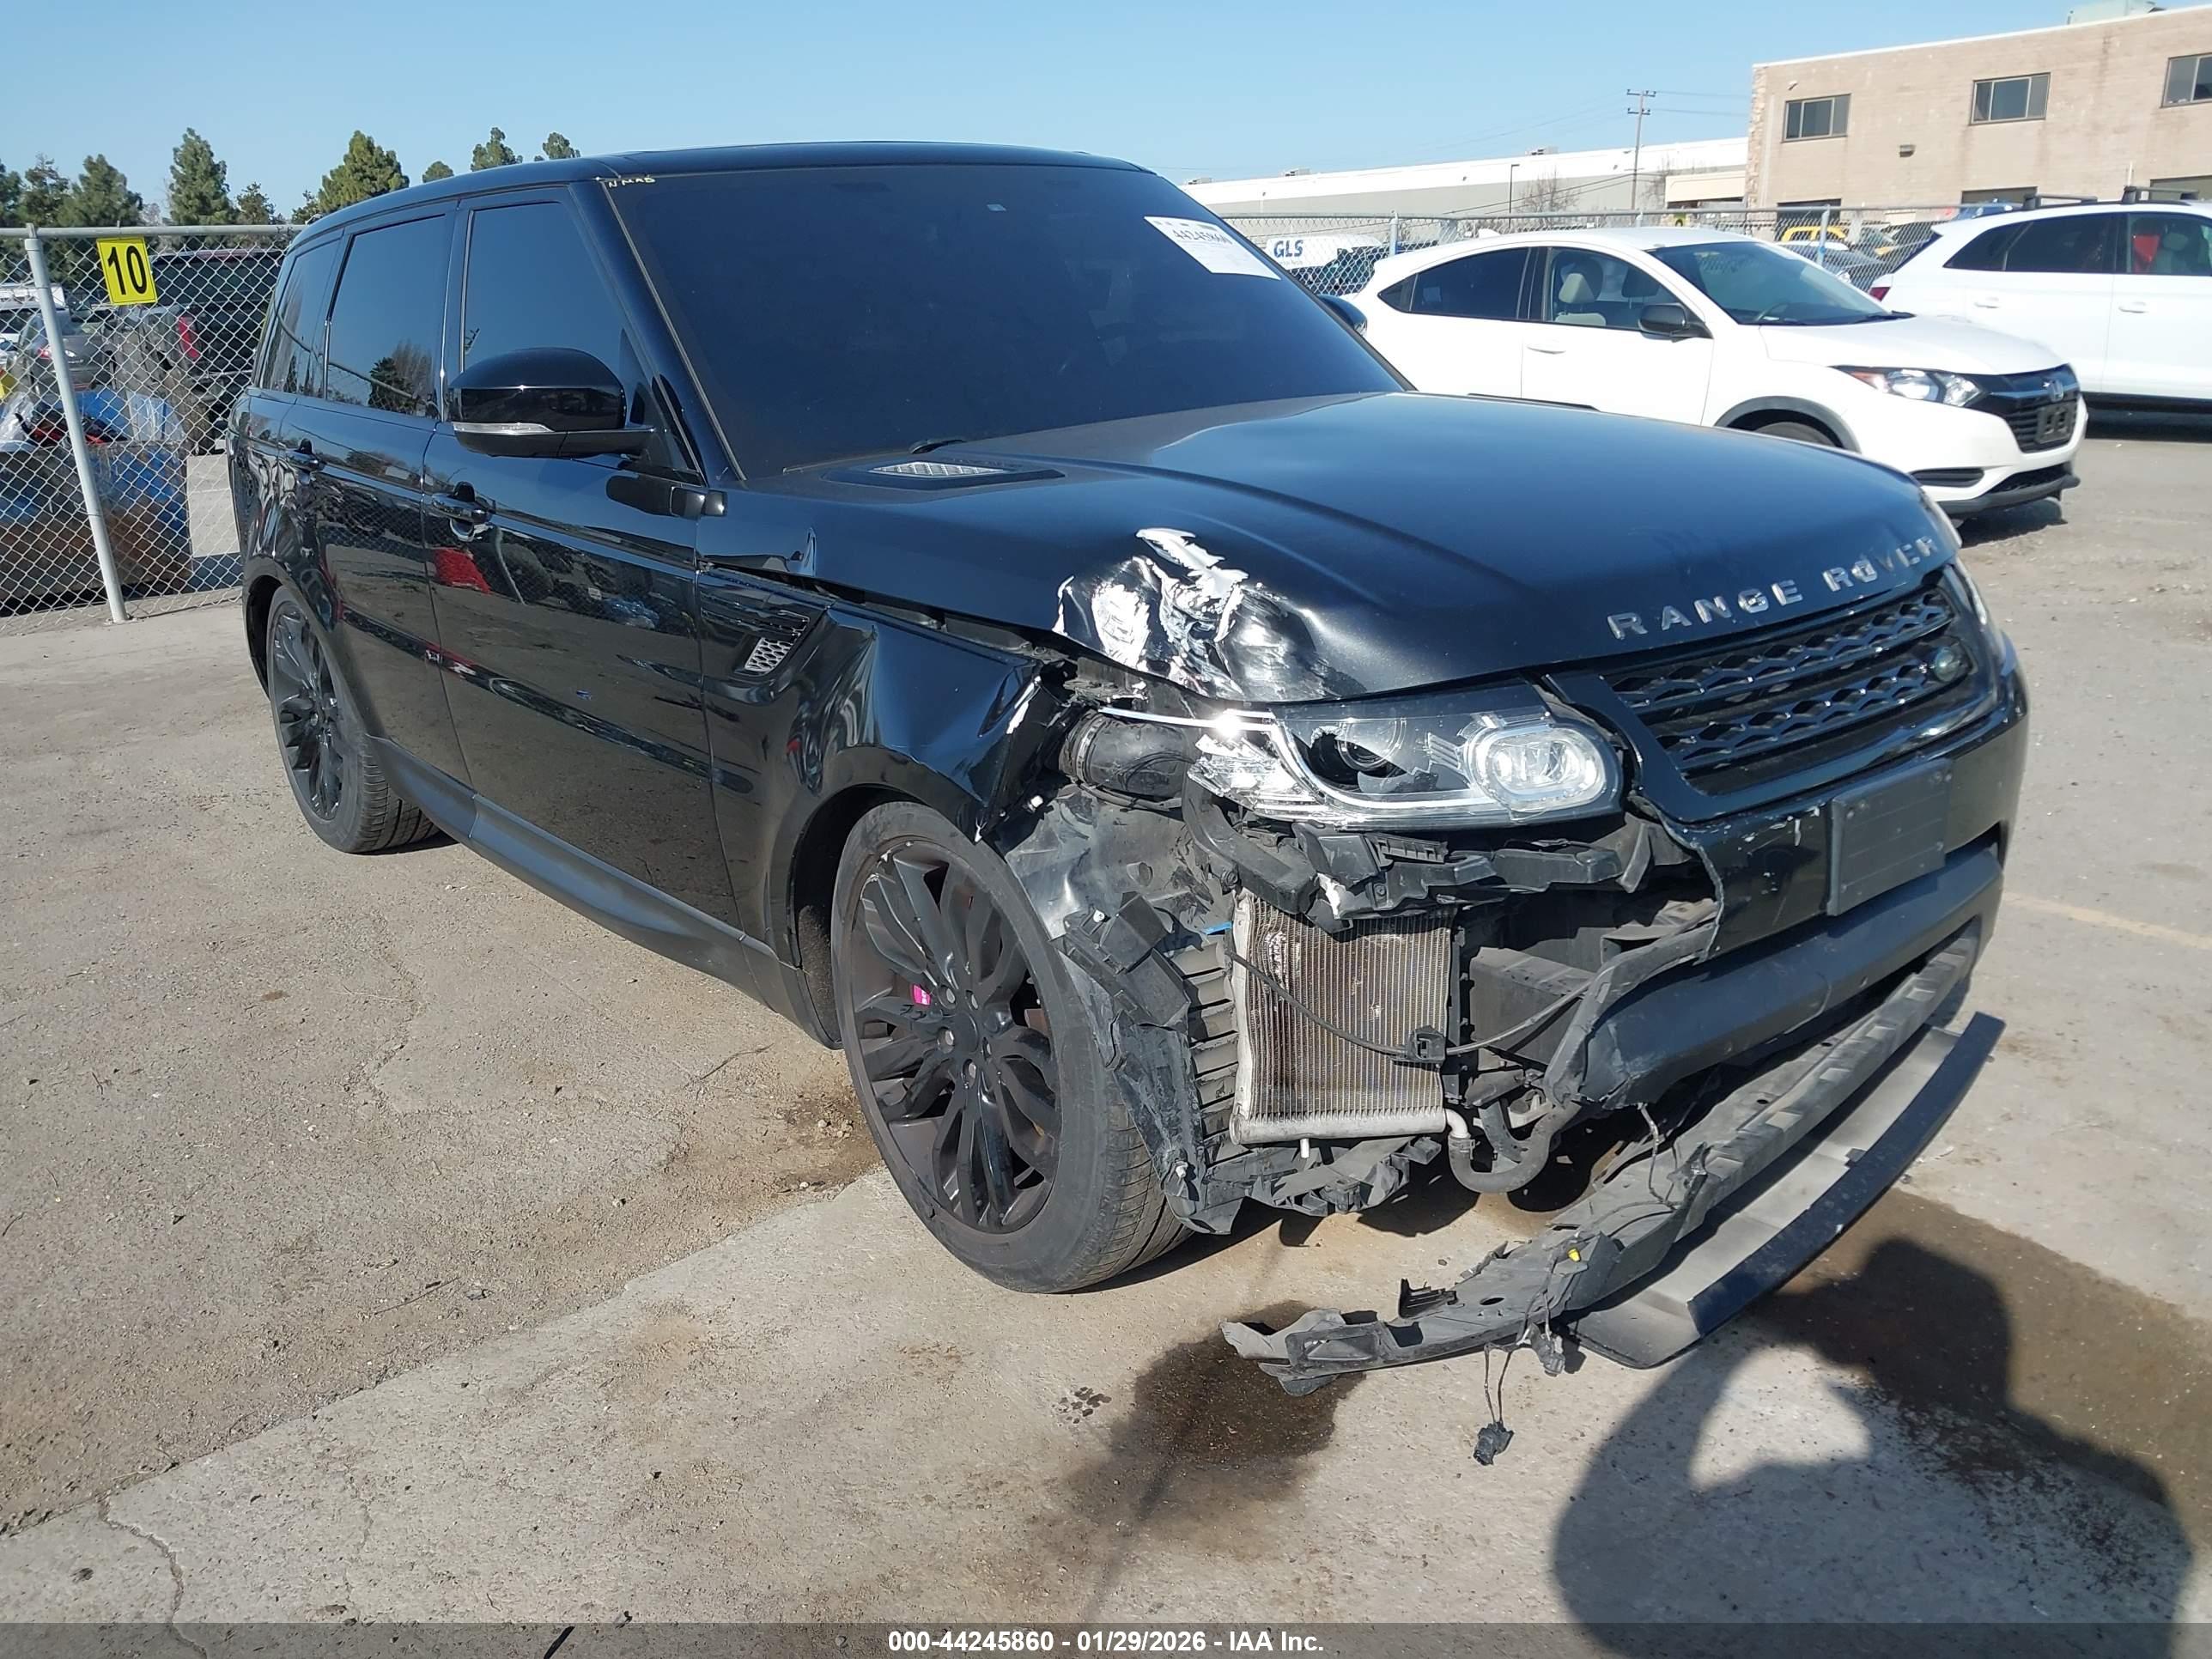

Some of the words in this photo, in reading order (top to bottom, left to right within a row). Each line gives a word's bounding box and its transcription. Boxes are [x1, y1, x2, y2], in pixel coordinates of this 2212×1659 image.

[107, 246, 148, 295] 10
[1273, 240, 1304, 258] GLS
[1607, 579, 1803, 641] RANGE
[1821, 535, 1939, 592] ROVER
